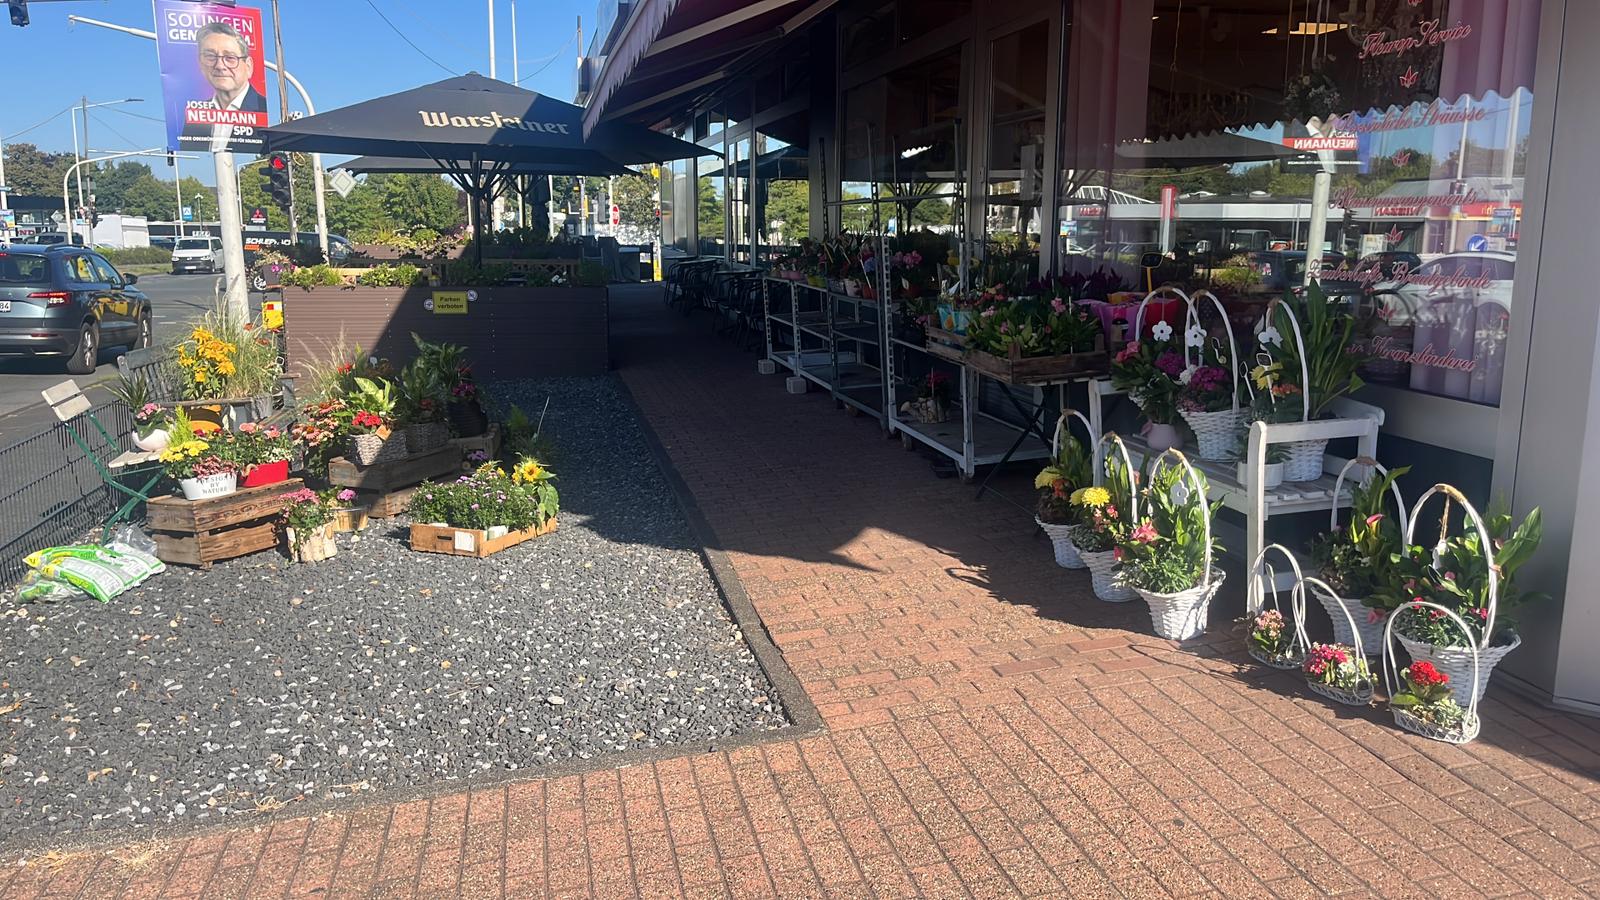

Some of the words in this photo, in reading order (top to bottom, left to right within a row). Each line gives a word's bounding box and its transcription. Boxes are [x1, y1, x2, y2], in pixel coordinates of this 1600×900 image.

[186, 100, 214, 110] JOSEF
[187, 109, 257, 125] NEUMANN
[418, 110, 569, 135] Warsteiner
[233, 125, 254, 136] SPD
[202, 486, 228, 494] NATURE
